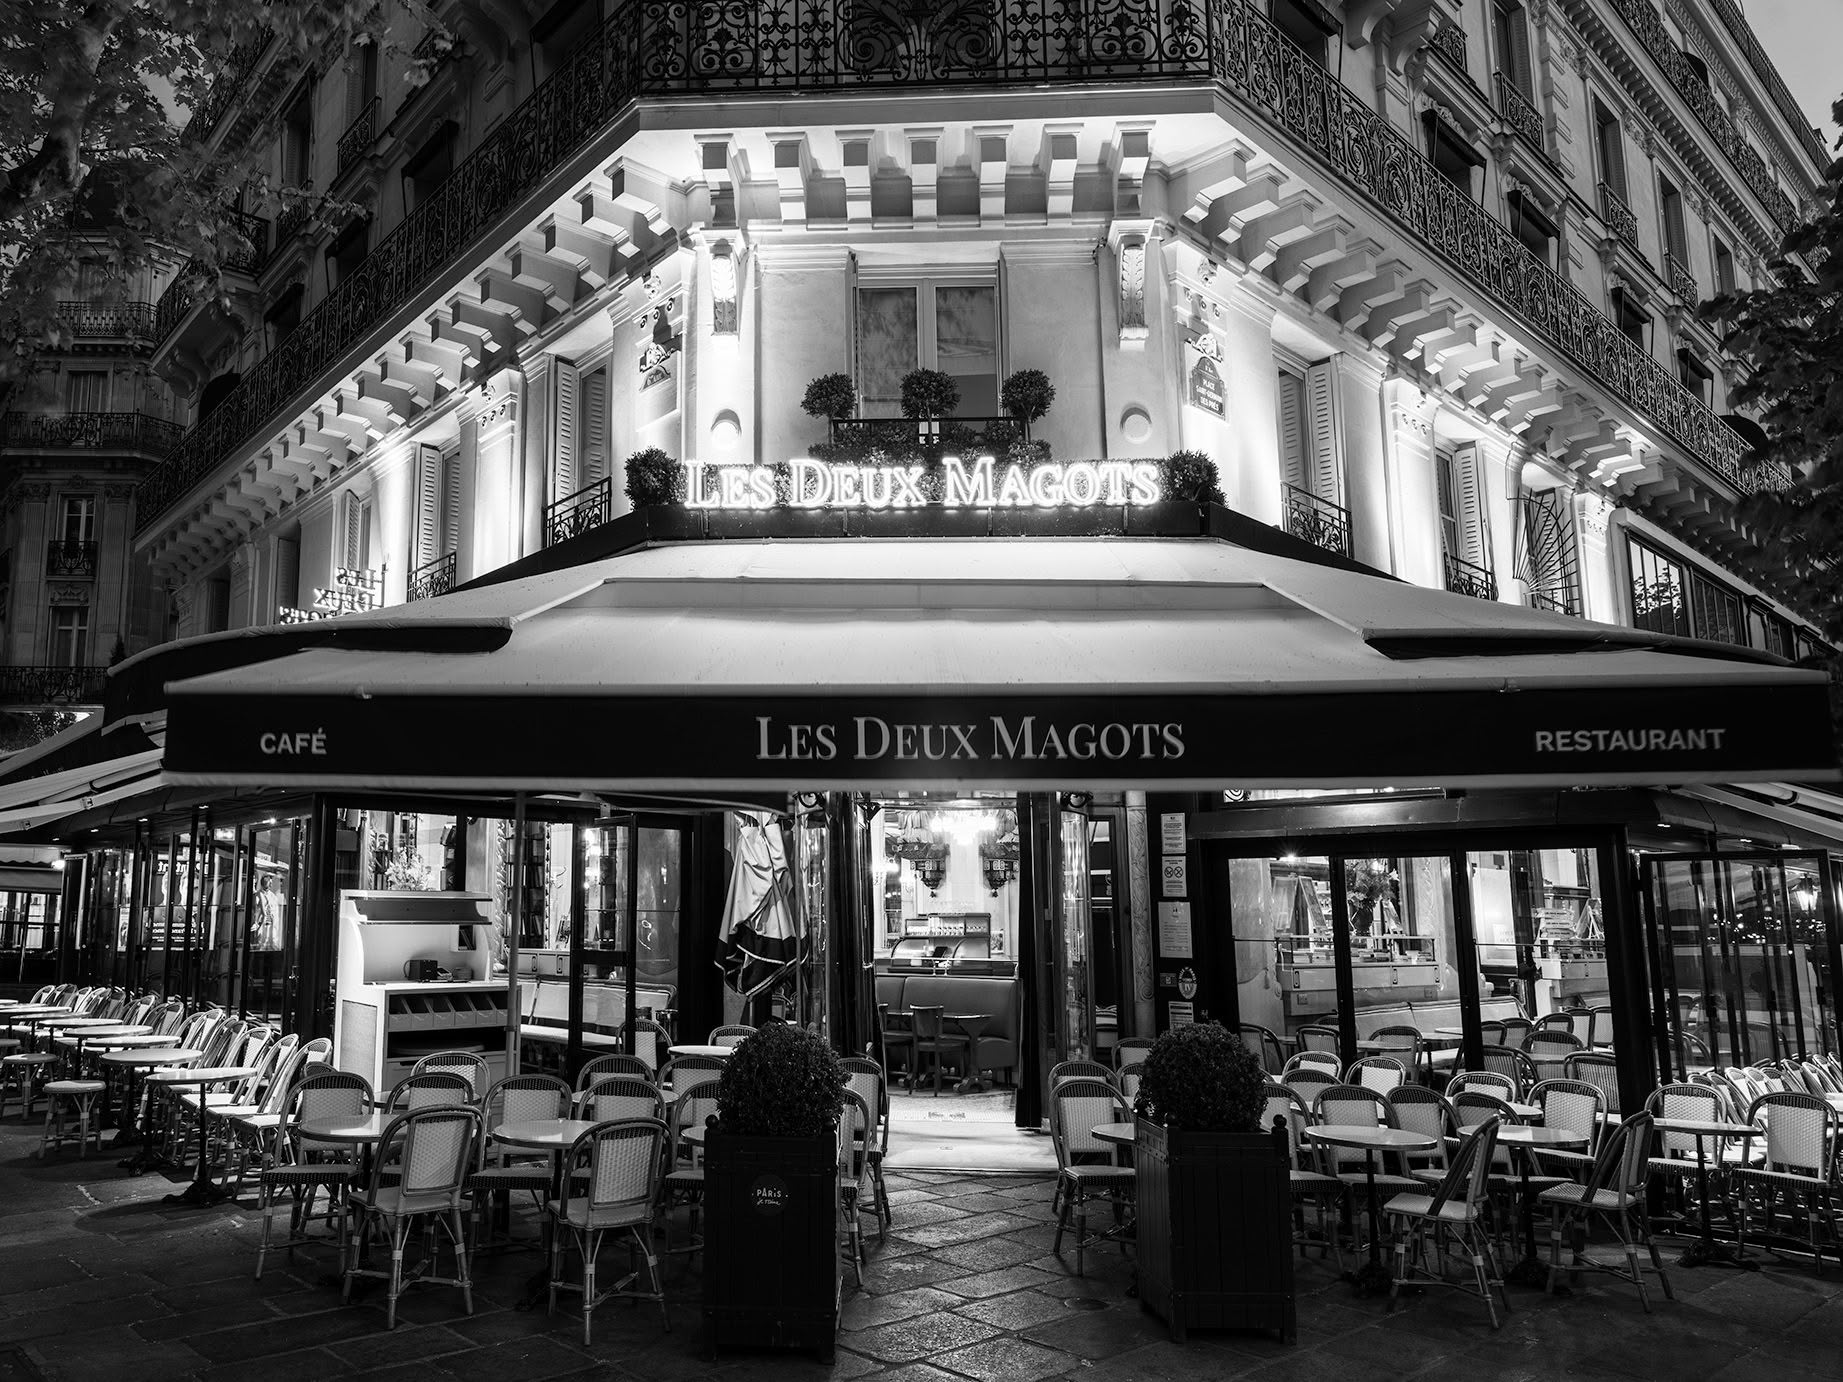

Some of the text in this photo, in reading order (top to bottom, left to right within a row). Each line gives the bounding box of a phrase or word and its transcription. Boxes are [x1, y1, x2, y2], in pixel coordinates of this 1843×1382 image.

[684, 456, 1161, 509] LES DEUX MAGOTS
[260, 727, 327, 755] CAFÉ
[756, 715, 1186, 761] LES DEUX MAGOTS
[1535, 728, 1727, 752] RESTAURANT
